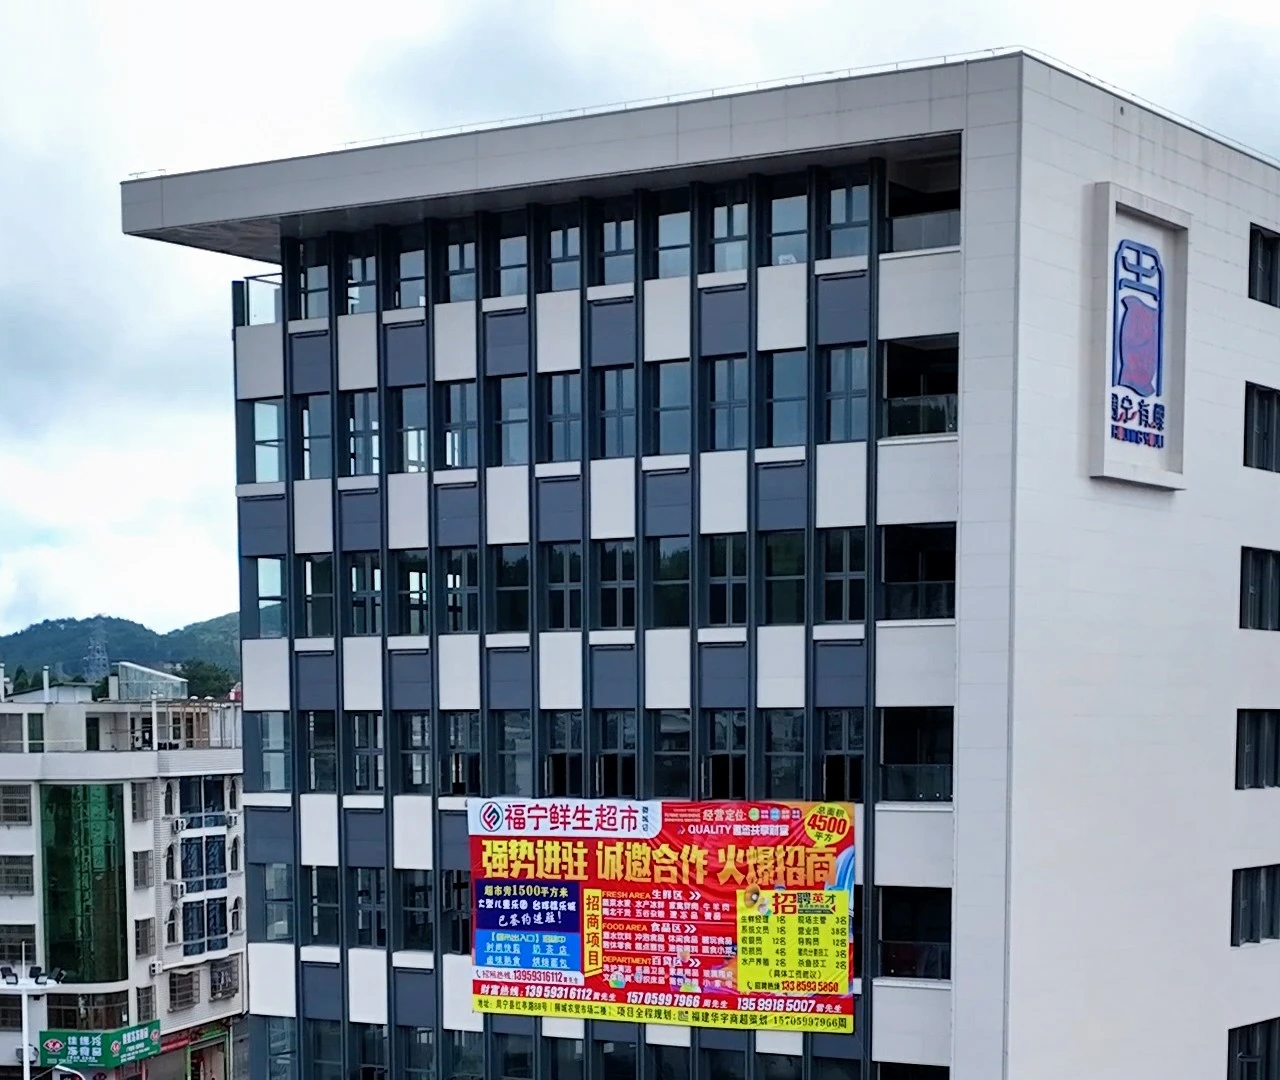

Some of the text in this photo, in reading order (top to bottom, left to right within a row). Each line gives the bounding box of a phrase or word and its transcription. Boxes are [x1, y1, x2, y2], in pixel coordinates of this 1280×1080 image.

[504, 803, 639, 833] 福宁鲜生超市
[807, 813, 847, 835] 4500
[687, 824, 731, 835] QUALITY
[814, 832, 833, 843] 平方
[482, 839, 837, 887] 强势进驻 诚邀合作 火爆招商
[602, 889, 683, 901] FRESH AREA 生鲜区
[772, 892, 837, 915] 招聘英才
[586, 894, 600, 966] 招商项目
[602, 922, 682, 933] FOOD AREA 食品区
[602, 955, 652, 965] DEPARTMENT
[513, 970, 563, 983] 13959316112
[524, 985, 543, 998] 139
[569, 988, 593, 1001] 6112
[626, 992, 643, 1003] 157
[785, 999, 816, 1013] 5007
